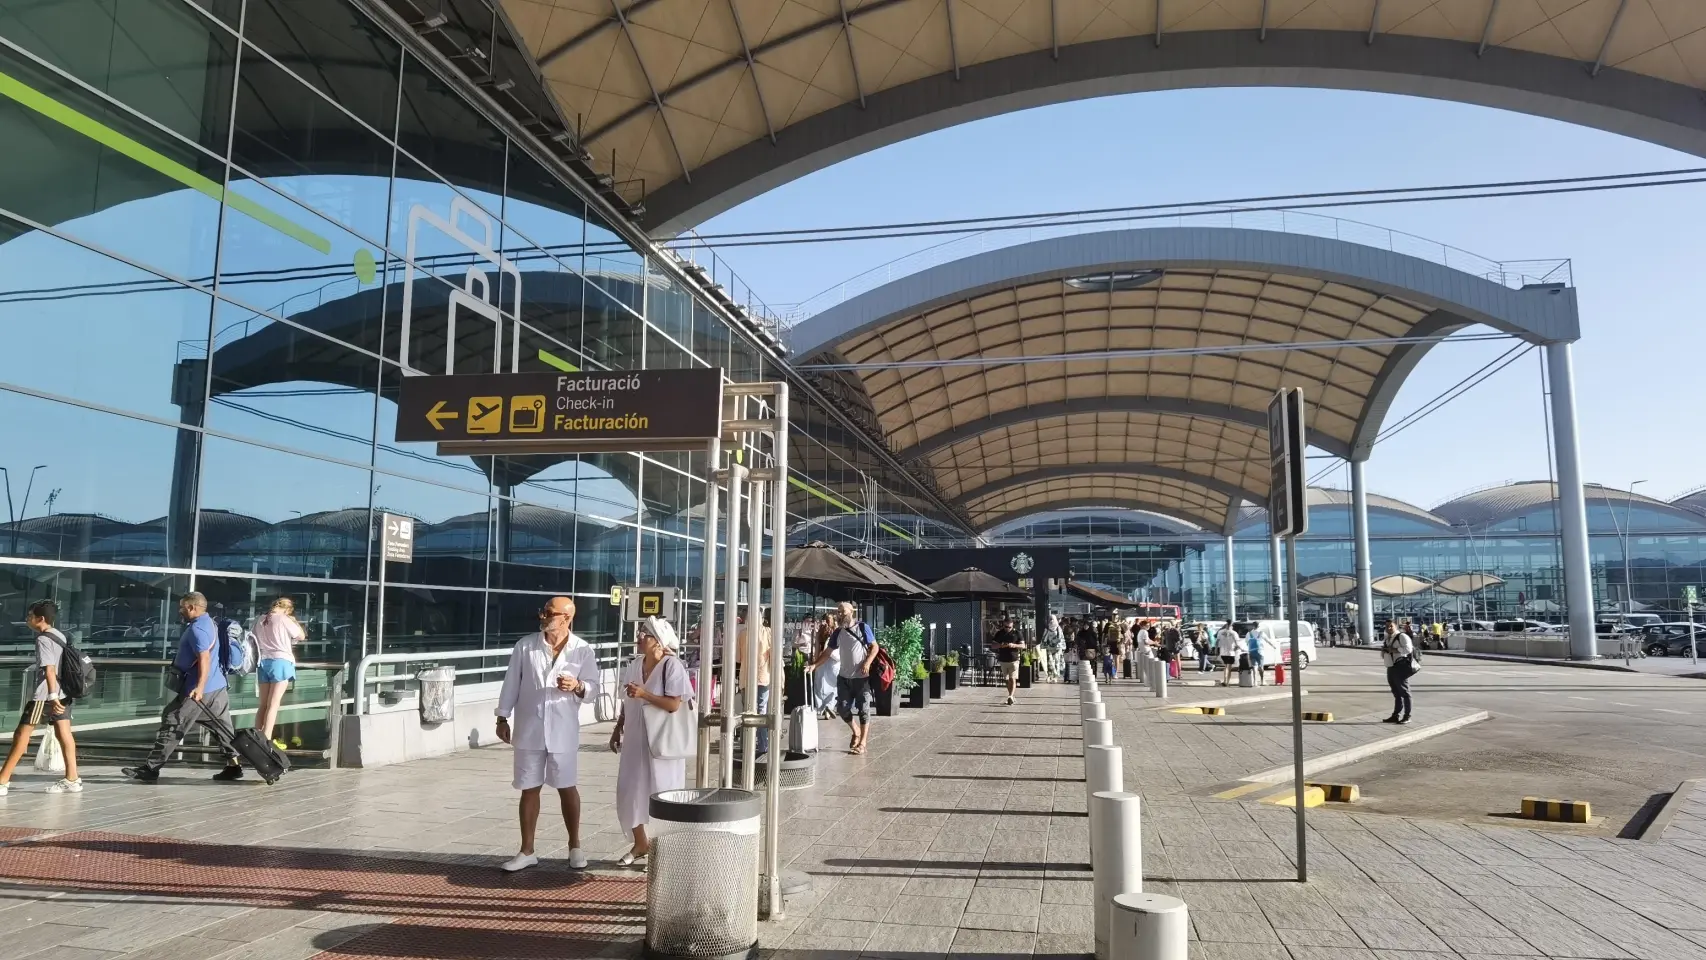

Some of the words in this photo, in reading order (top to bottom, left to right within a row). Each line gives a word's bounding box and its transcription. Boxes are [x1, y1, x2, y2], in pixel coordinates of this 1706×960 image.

[556, 374, 640, 392] Facturació
[556, 396, 614, 410] Check-in
[554, 412, 648, 430] Facturación
